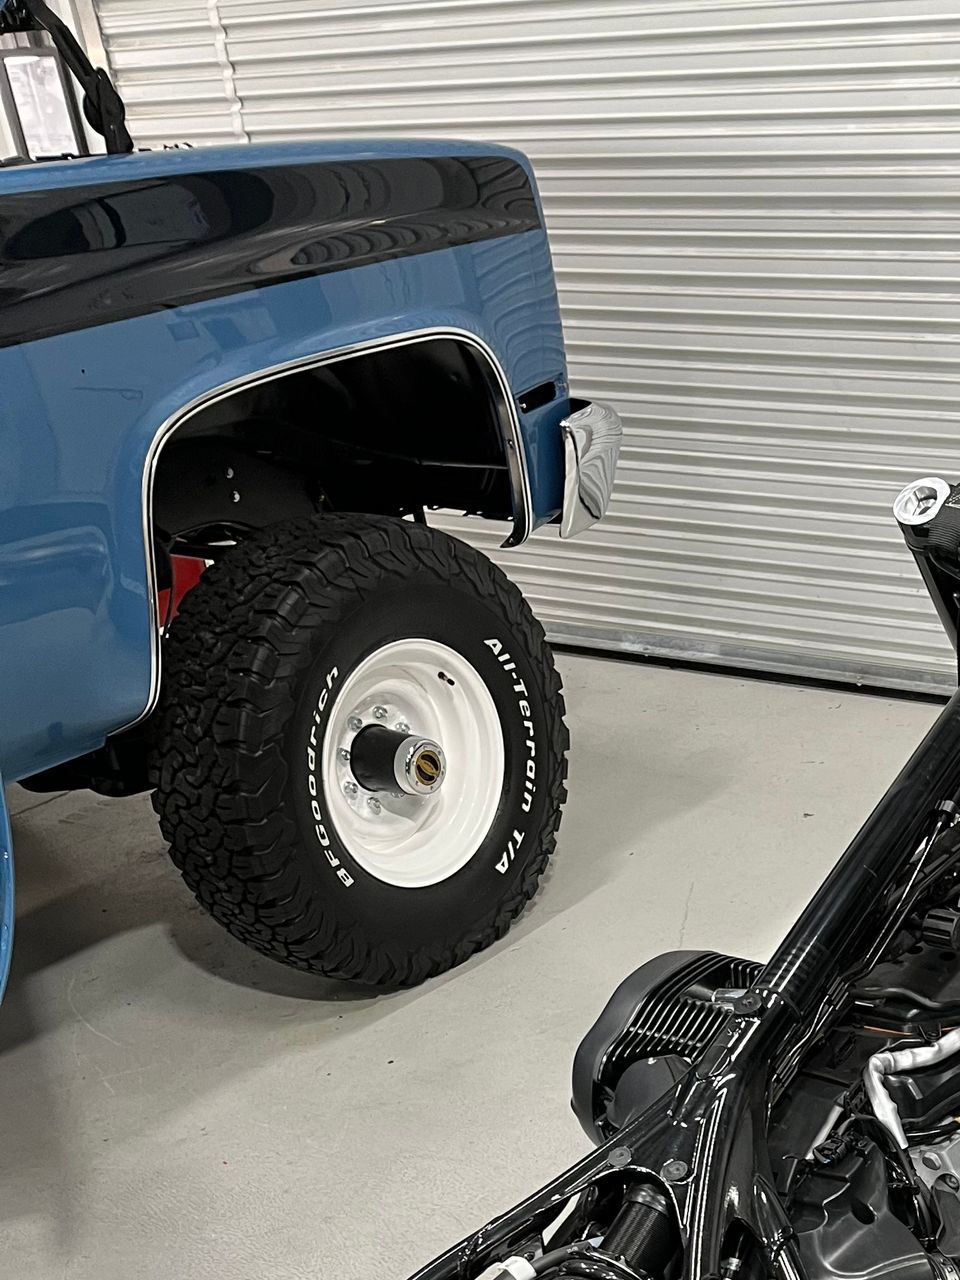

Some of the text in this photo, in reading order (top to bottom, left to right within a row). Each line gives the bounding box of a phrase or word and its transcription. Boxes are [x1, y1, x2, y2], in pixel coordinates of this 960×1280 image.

[304, 666, 354, 888] BFGoodrich
[484, 638, 537, 874] All-Terrain T/A
